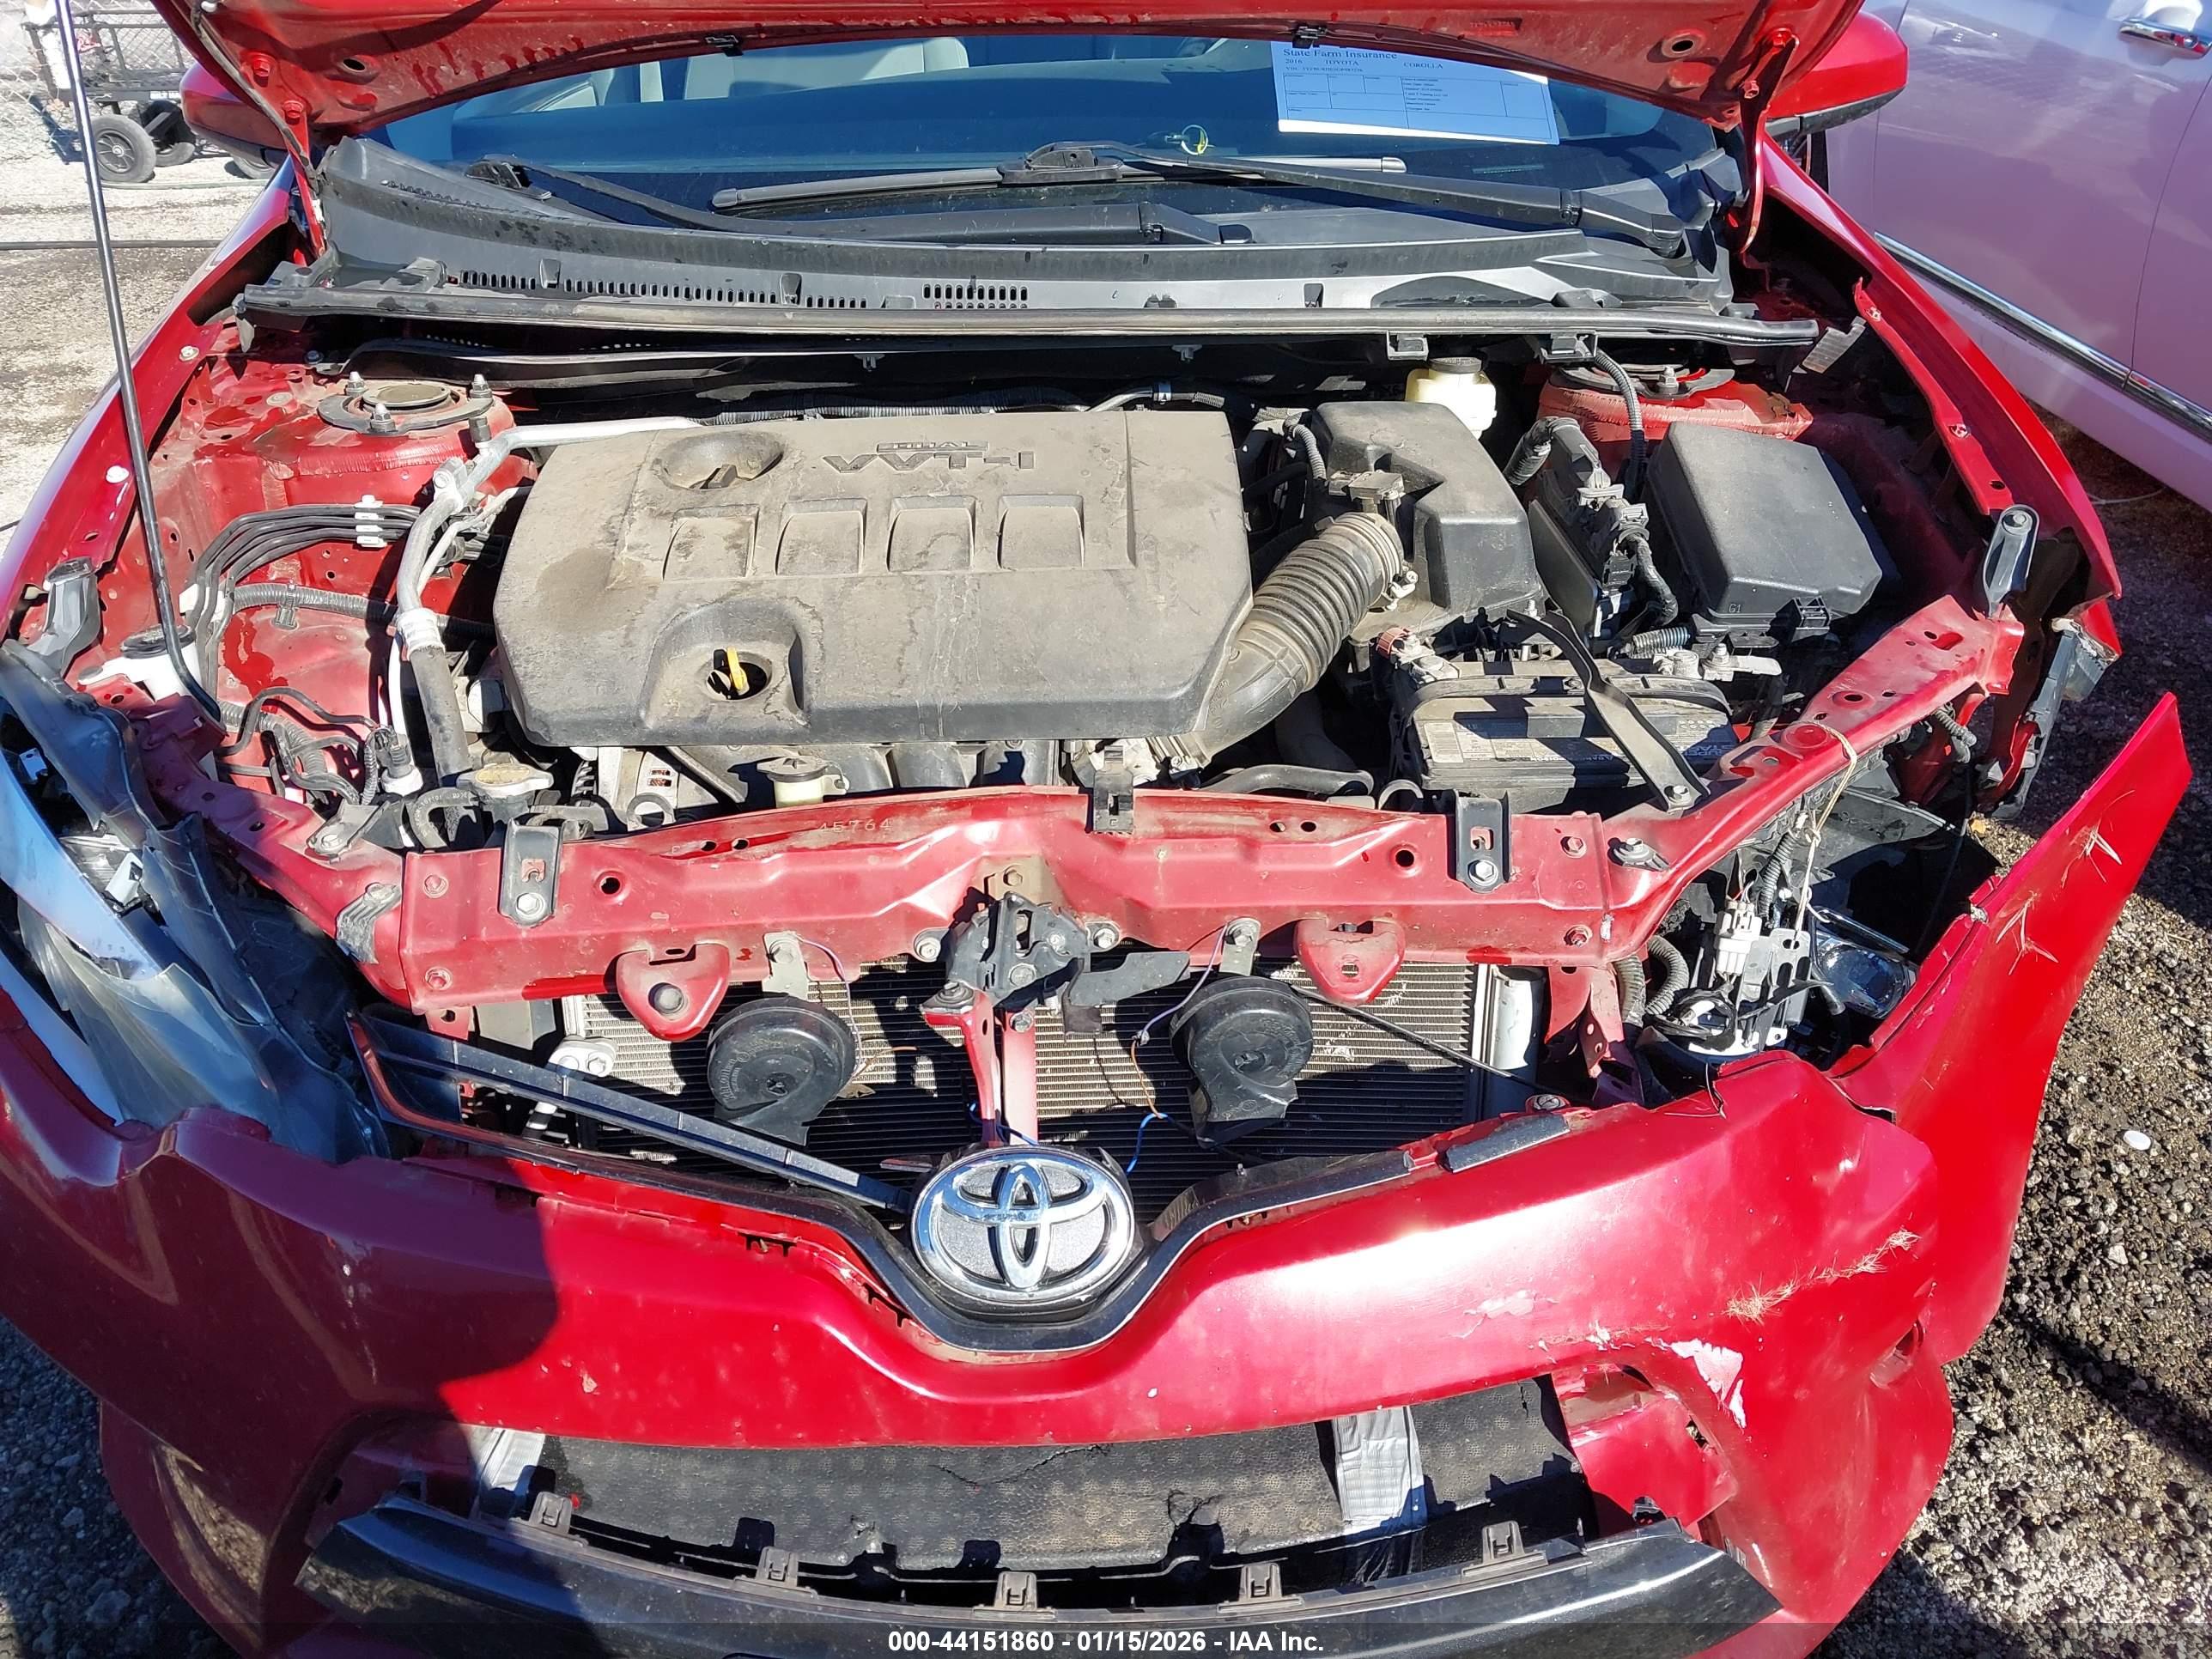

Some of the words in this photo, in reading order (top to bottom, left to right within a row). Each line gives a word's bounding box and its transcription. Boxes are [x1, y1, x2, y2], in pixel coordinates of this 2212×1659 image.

[1283, 48, 1310, 57] State
[1346, 51, 1398, 59] Insurance
[1729, 603, 1741, 613] G1
[817, 818, 893, 833] 45764
